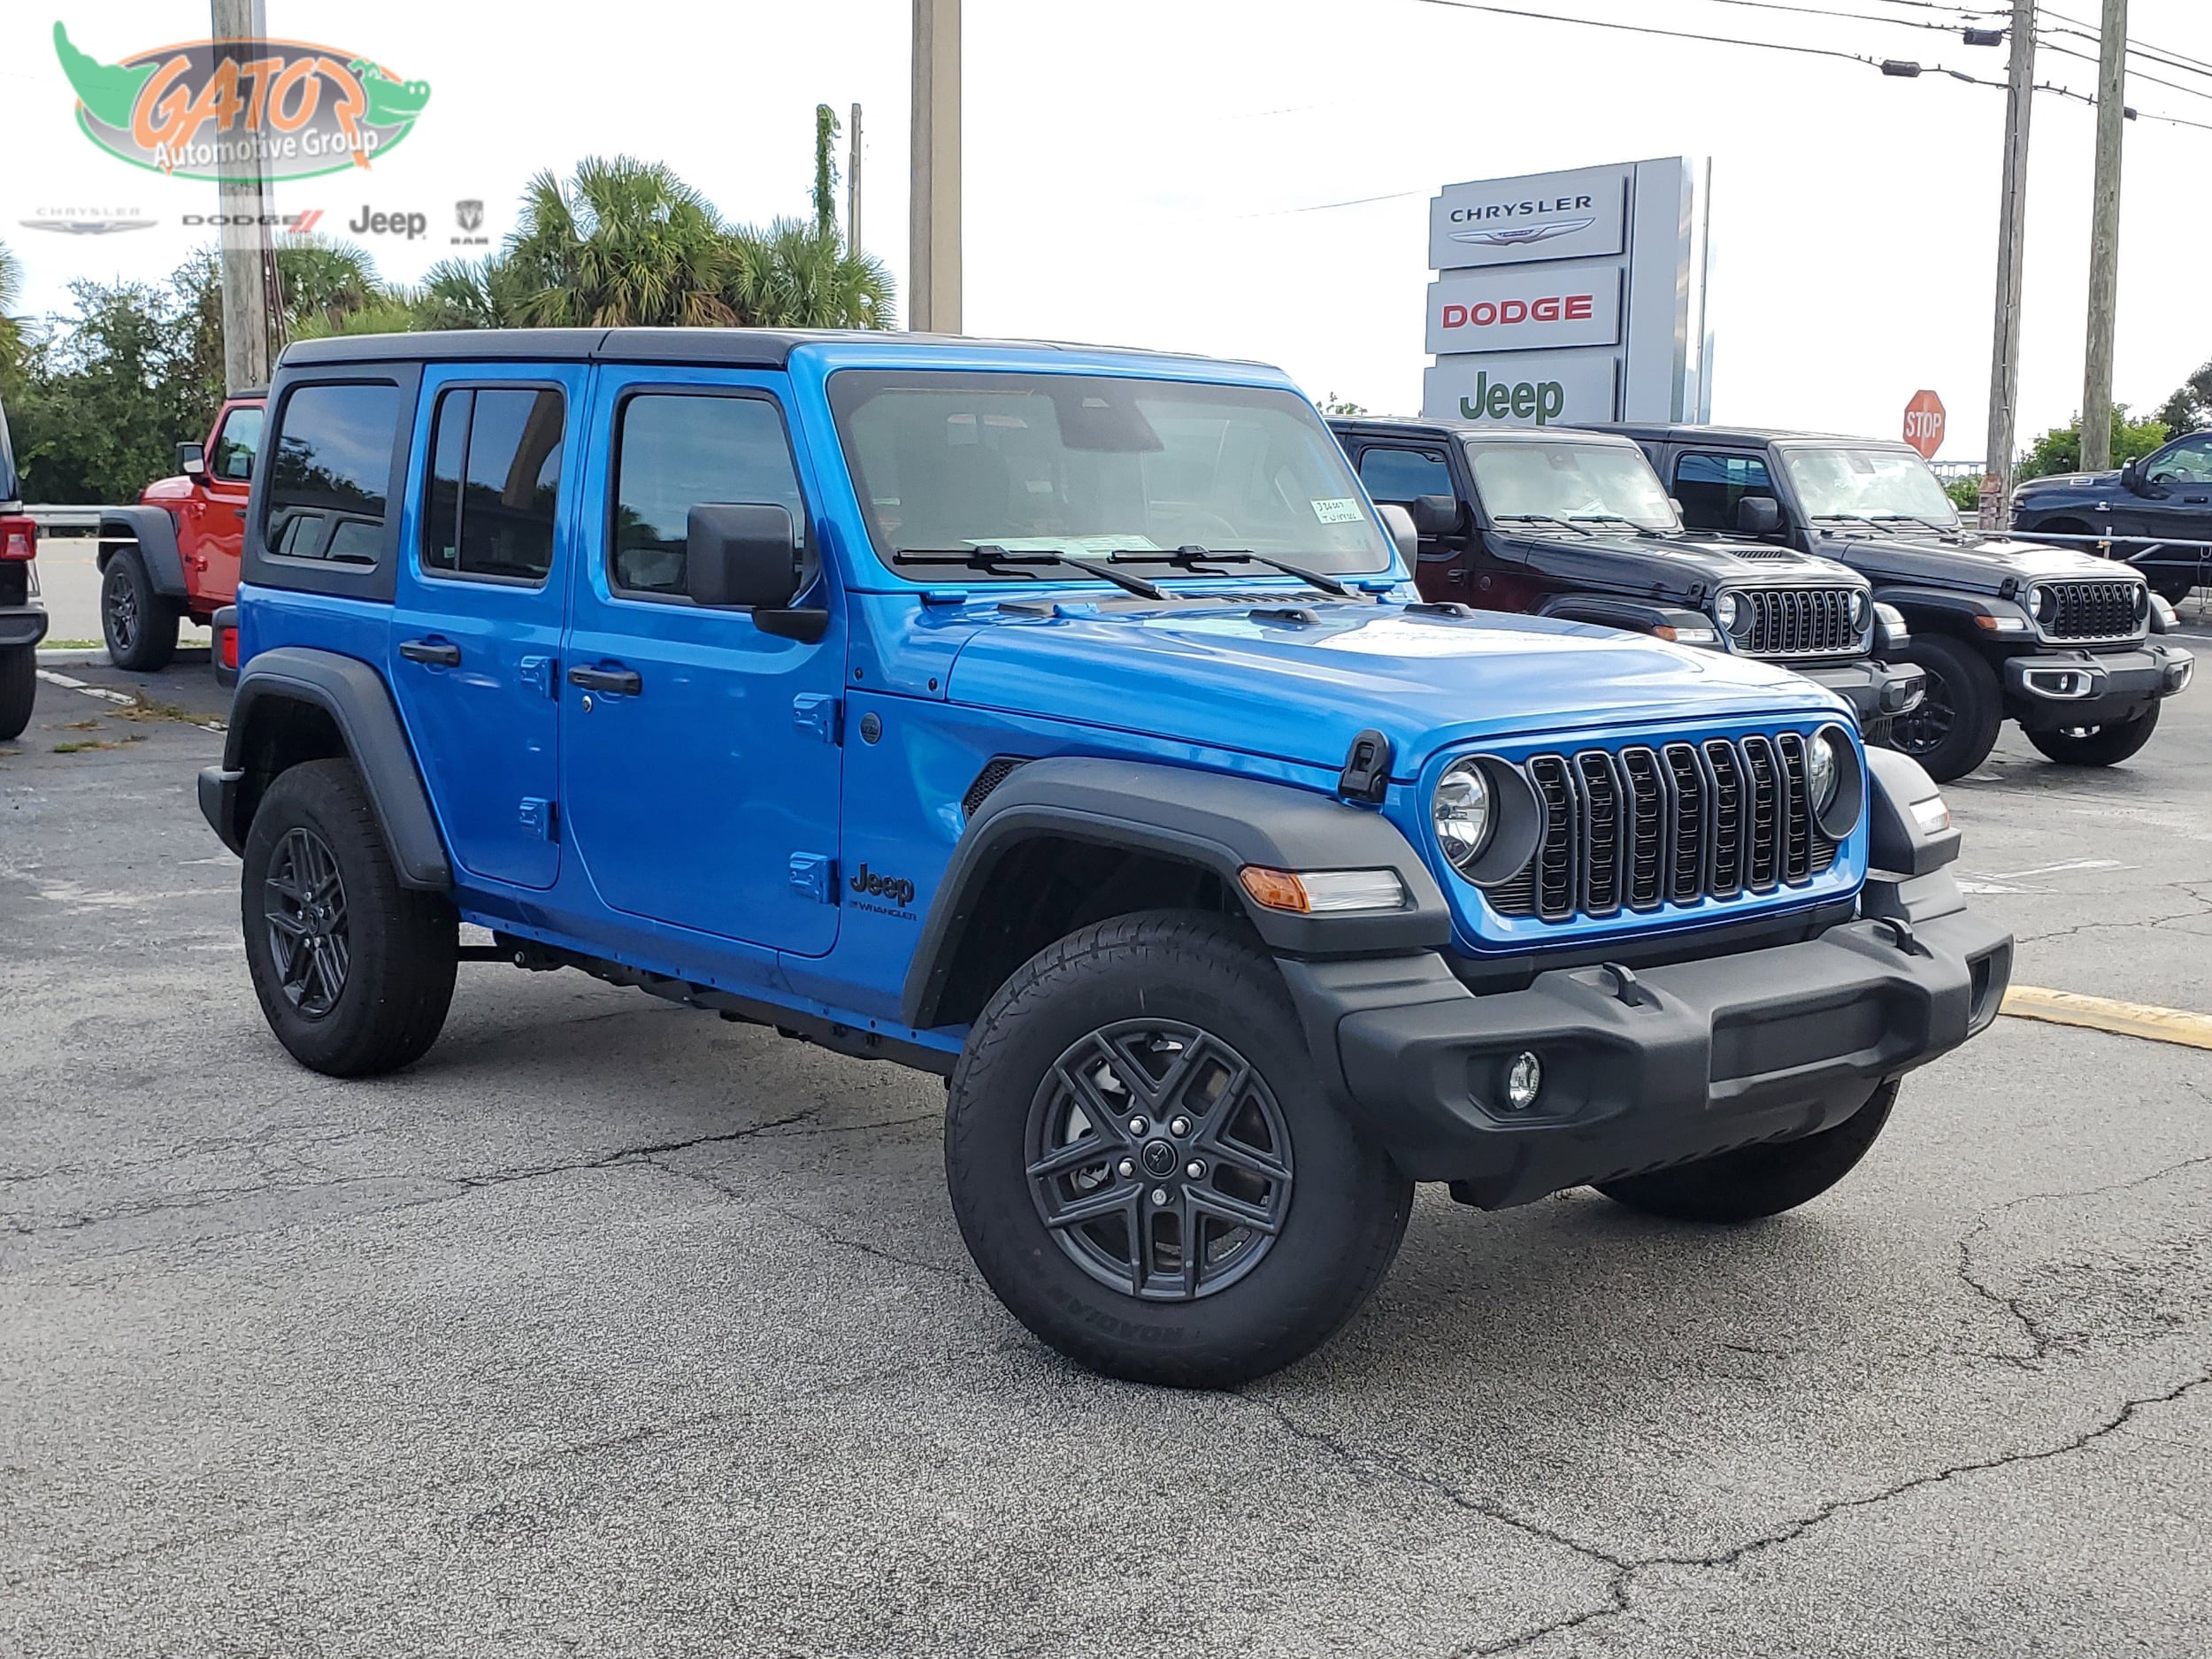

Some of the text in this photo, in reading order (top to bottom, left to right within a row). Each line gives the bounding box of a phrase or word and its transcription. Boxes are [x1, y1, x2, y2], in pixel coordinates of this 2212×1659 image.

[1449, 196, 1593, 223] CHRYSLER
[1442, 295, 1594, 328] DODGE
[1460, 371, 1564, 425] Jeep
[1906, 411, 1942, 438] STOP
[849, 863, 915, 908] Jeep
[858, 902, 918, 921] WRANGLER
